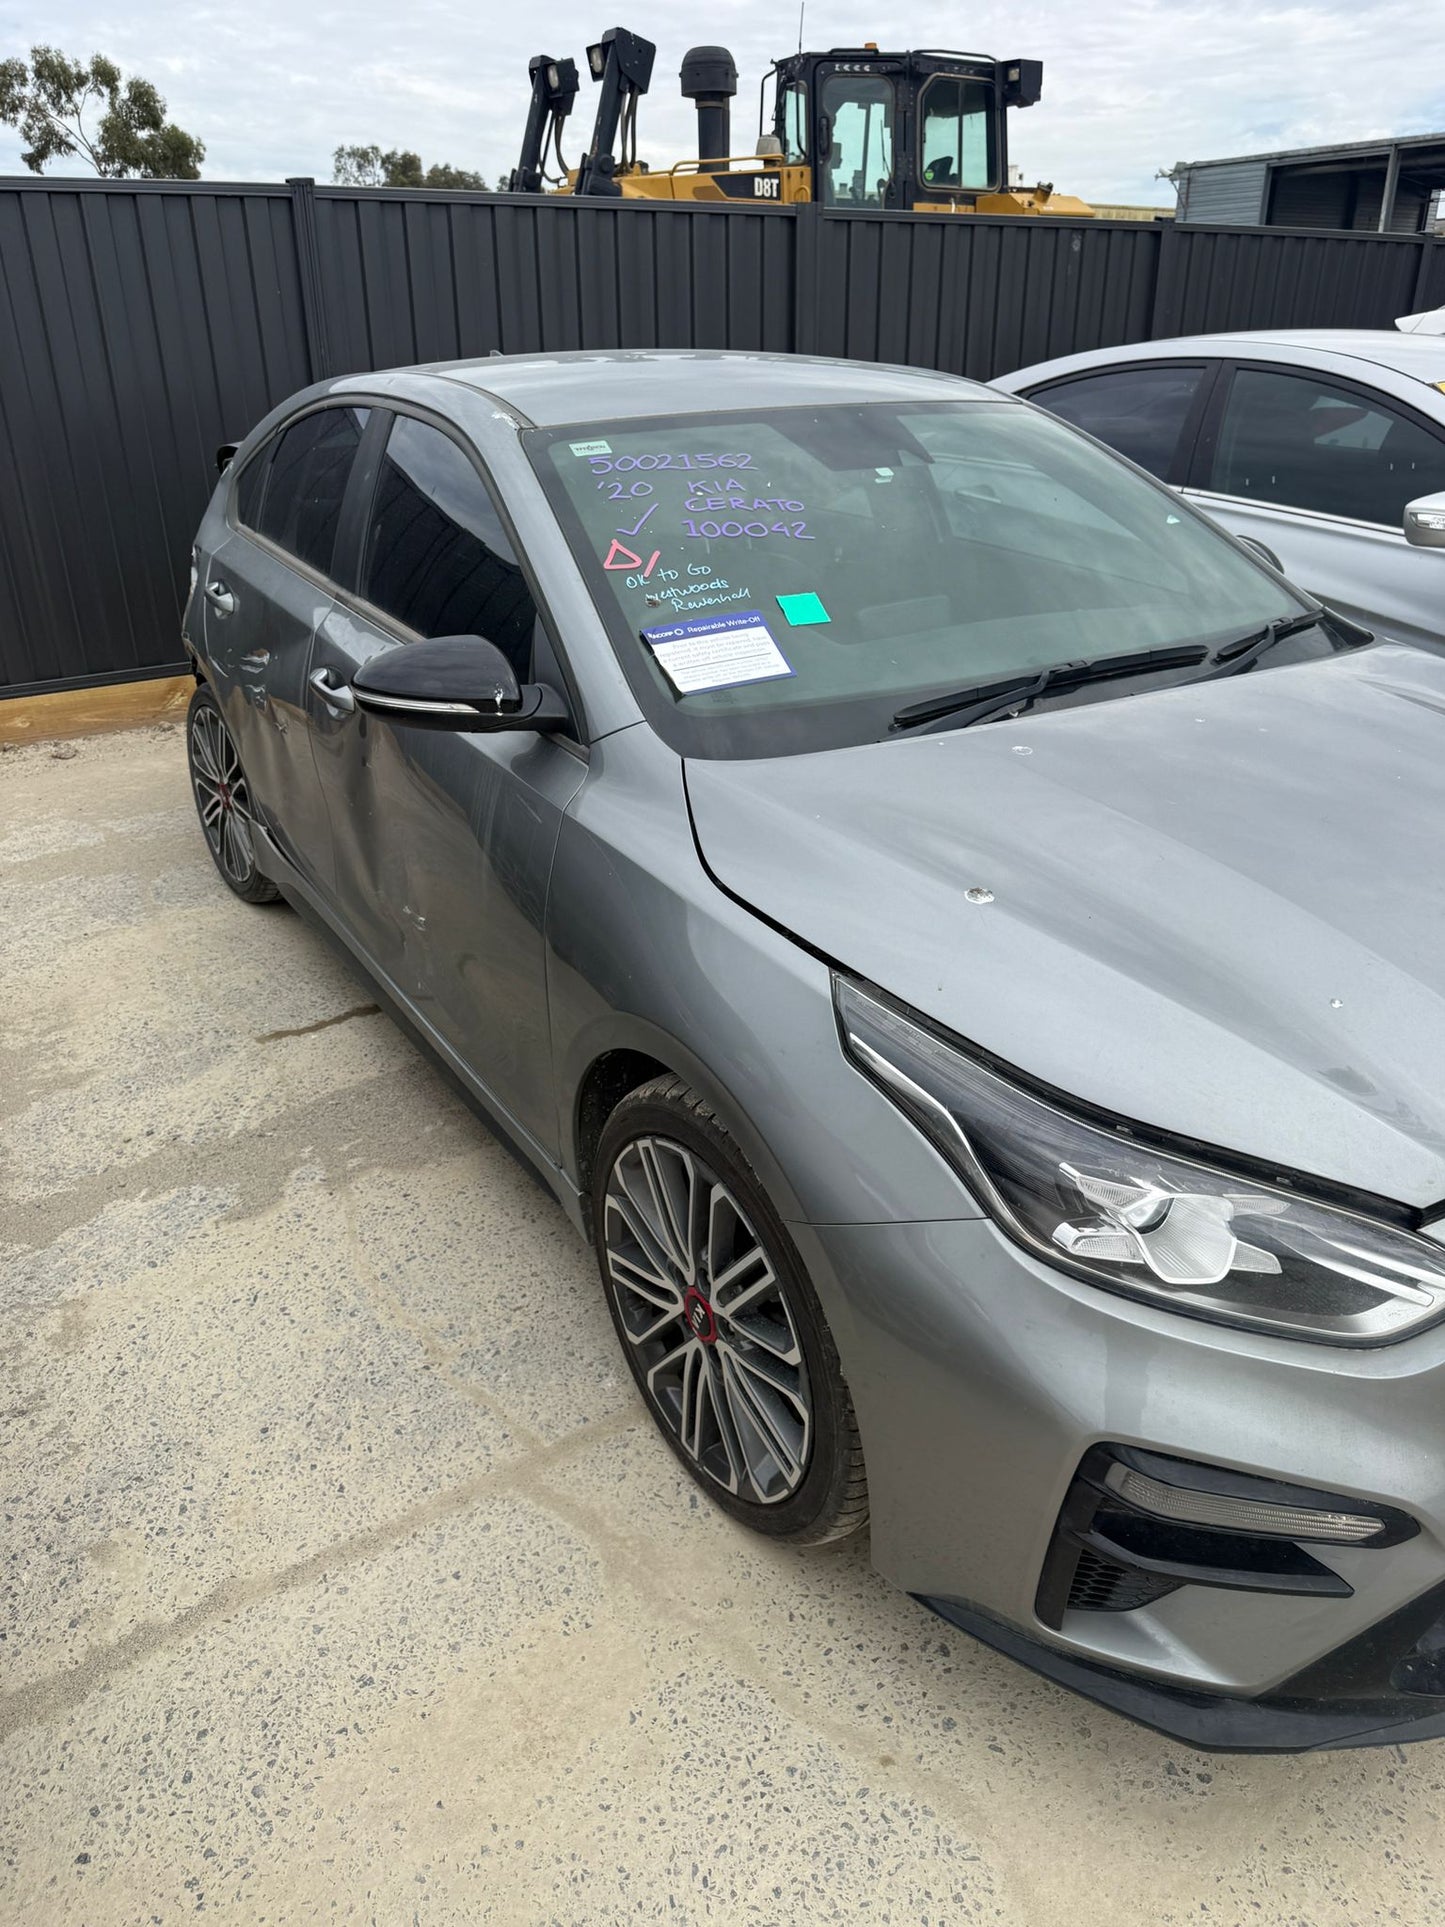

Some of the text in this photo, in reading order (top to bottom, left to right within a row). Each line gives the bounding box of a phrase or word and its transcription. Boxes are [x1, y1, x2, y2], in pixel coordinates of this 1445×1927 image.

[754, 176, 779, 198] D8T
[588, 453, 759, 475] 50021562
[687, 478, 746, 494] KIA
[684, 497, 805, 511] CERATO
[681, 519, 816, 539] 100042
[687, 621, 727, 634] Repairable
